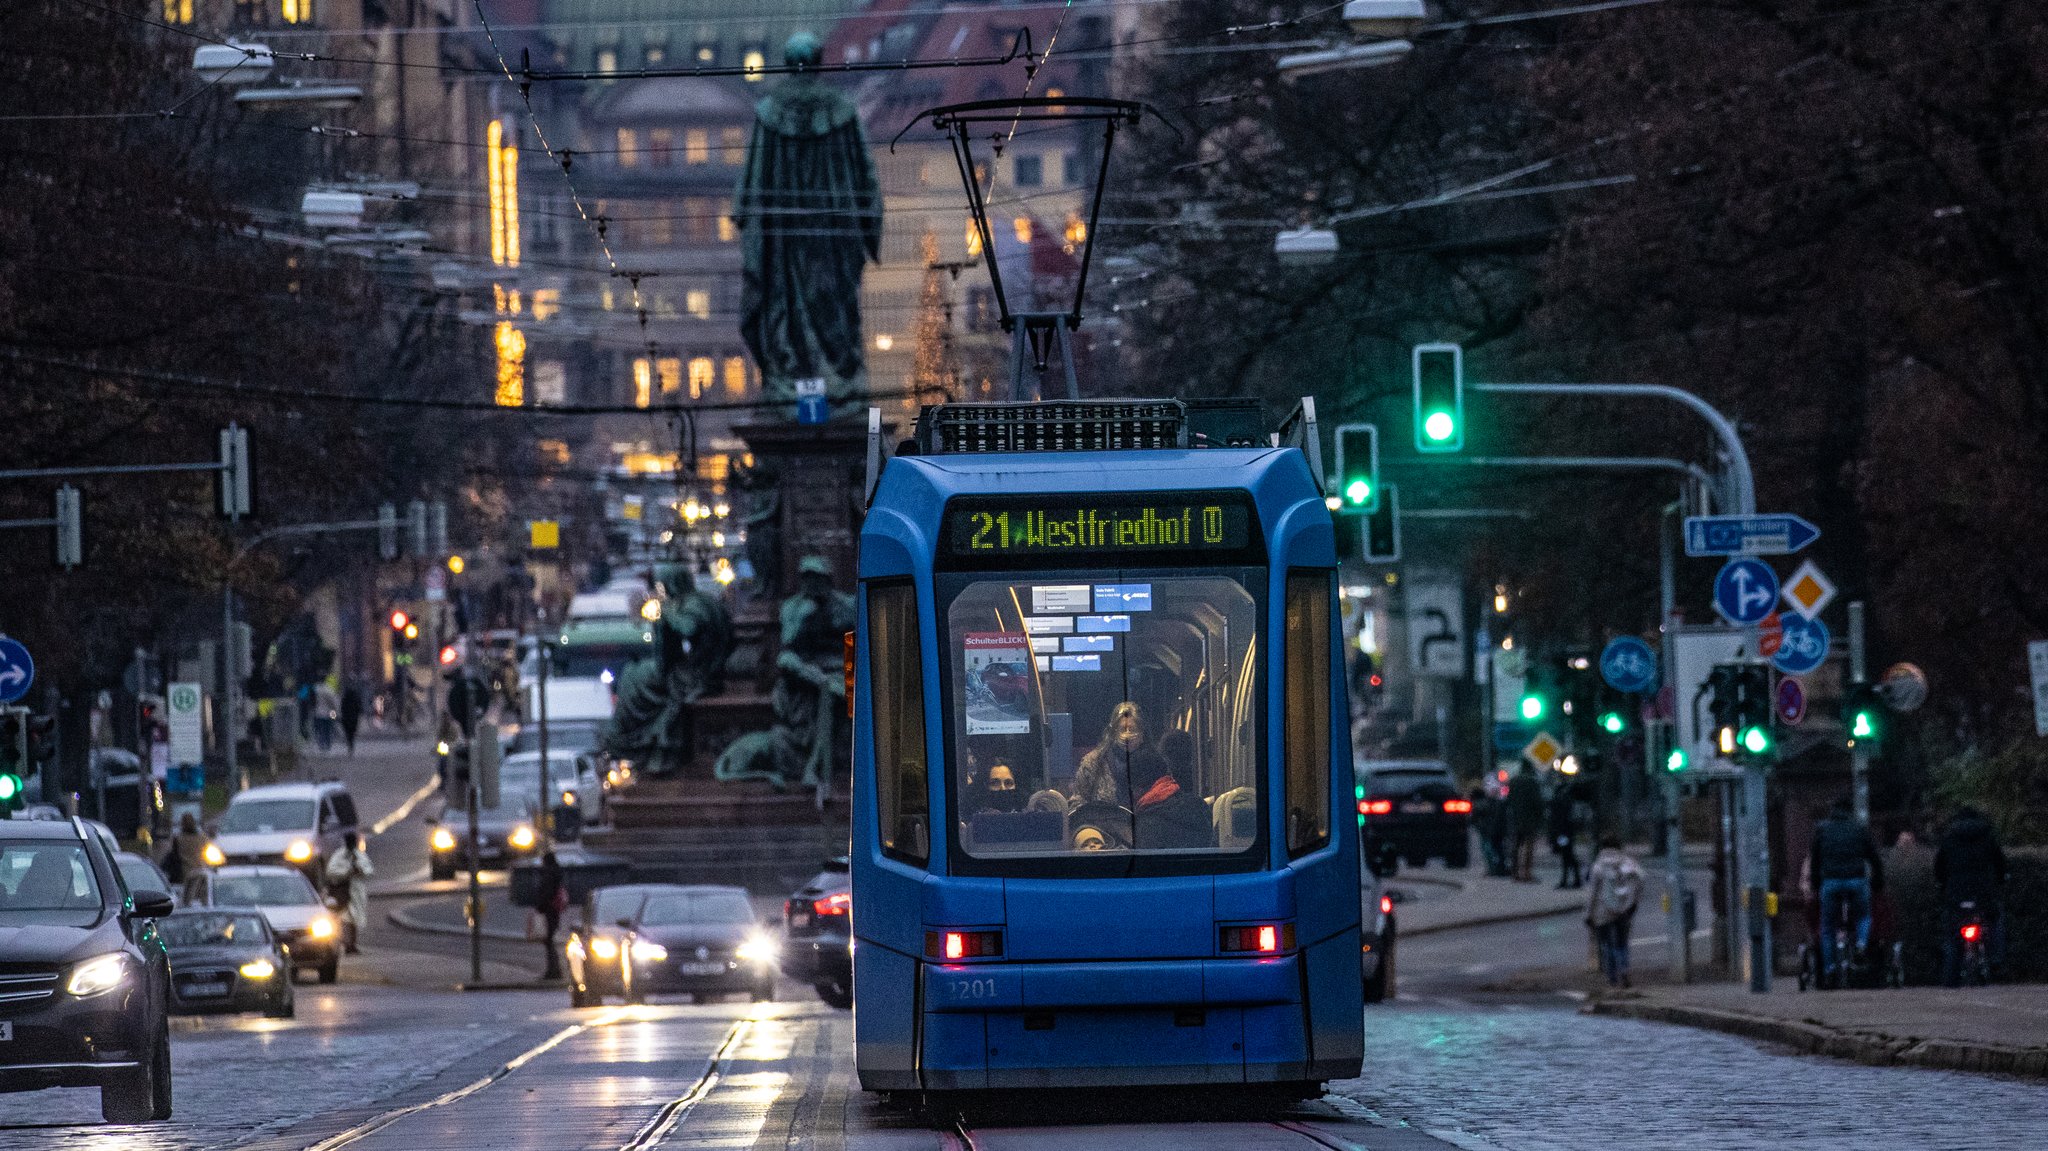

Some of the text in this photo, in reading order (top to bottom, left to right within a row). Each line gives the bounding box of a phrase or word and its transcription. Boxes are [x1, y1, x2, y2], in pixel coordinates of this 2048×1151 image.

[971, 512, 1009, 549] 21
[1027, 507, 1191, 547] Westfriedhof
[965, 636, 1026, 645] SchulterBLICK!
